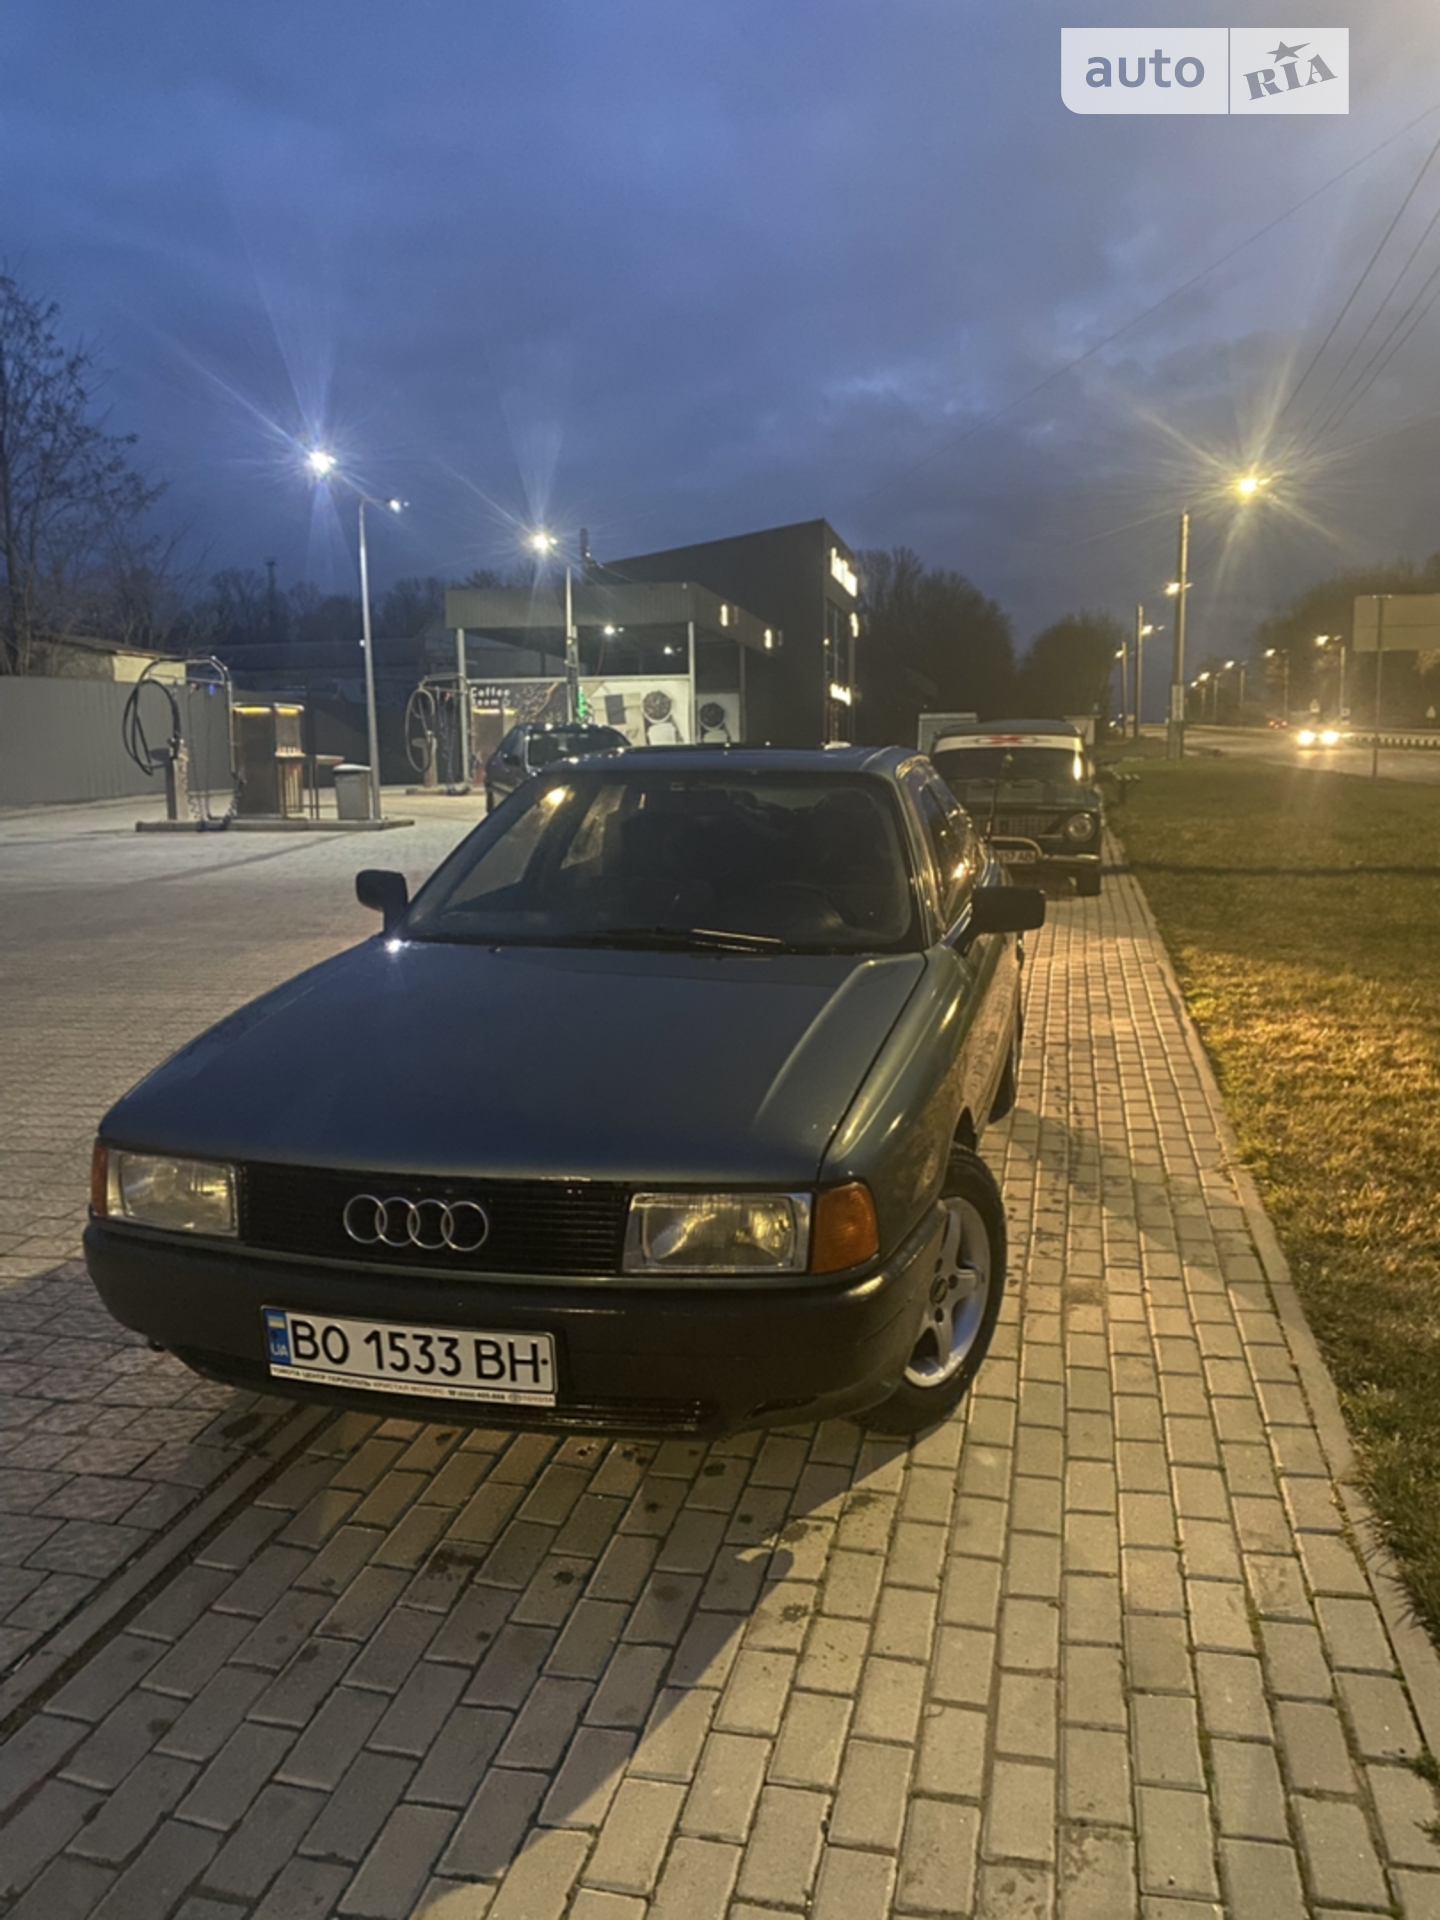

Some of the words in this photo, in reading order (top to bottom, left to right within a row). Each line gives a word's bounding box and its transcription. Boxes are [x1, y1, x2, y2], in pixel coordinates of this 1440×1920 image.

[270, 1342, 288, 1356] UA
[290, 1319, 350, 1366] BO
[363, 1329, 462, 1377] 1533
[473, 1338, 541, 1383] BH
